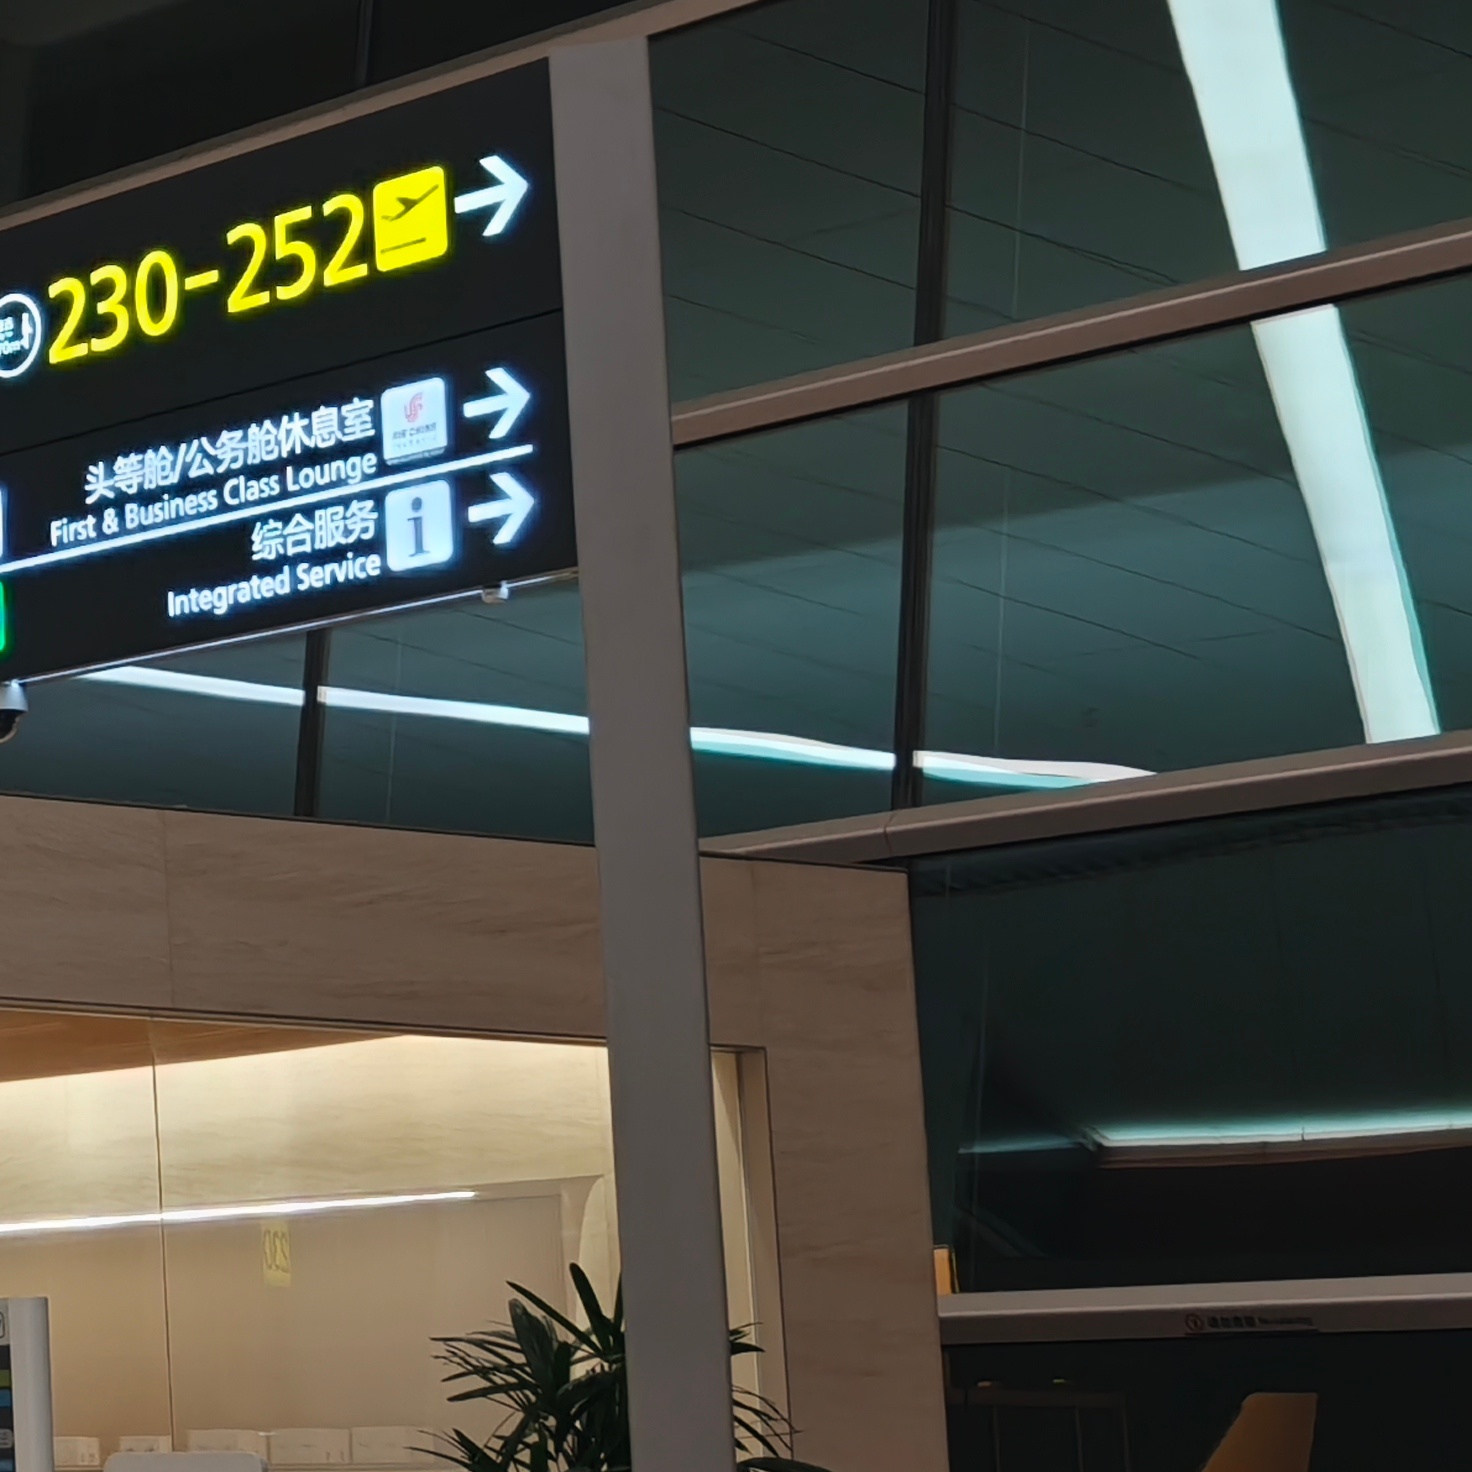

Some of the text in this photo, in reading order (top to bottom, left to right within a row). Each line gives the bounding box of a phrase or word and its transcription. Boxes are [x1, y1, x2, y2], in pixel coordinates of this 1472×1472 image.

[47, 193, 368, 365] 230-252
[84, 396, 376, 505] 头等舱/公务舱休息室
[49, 451, 378, 547] First & Business Class Lounge
[251, 499, 378, 562] 综合服务
[166, 552, 382, 618] Integrated Service
